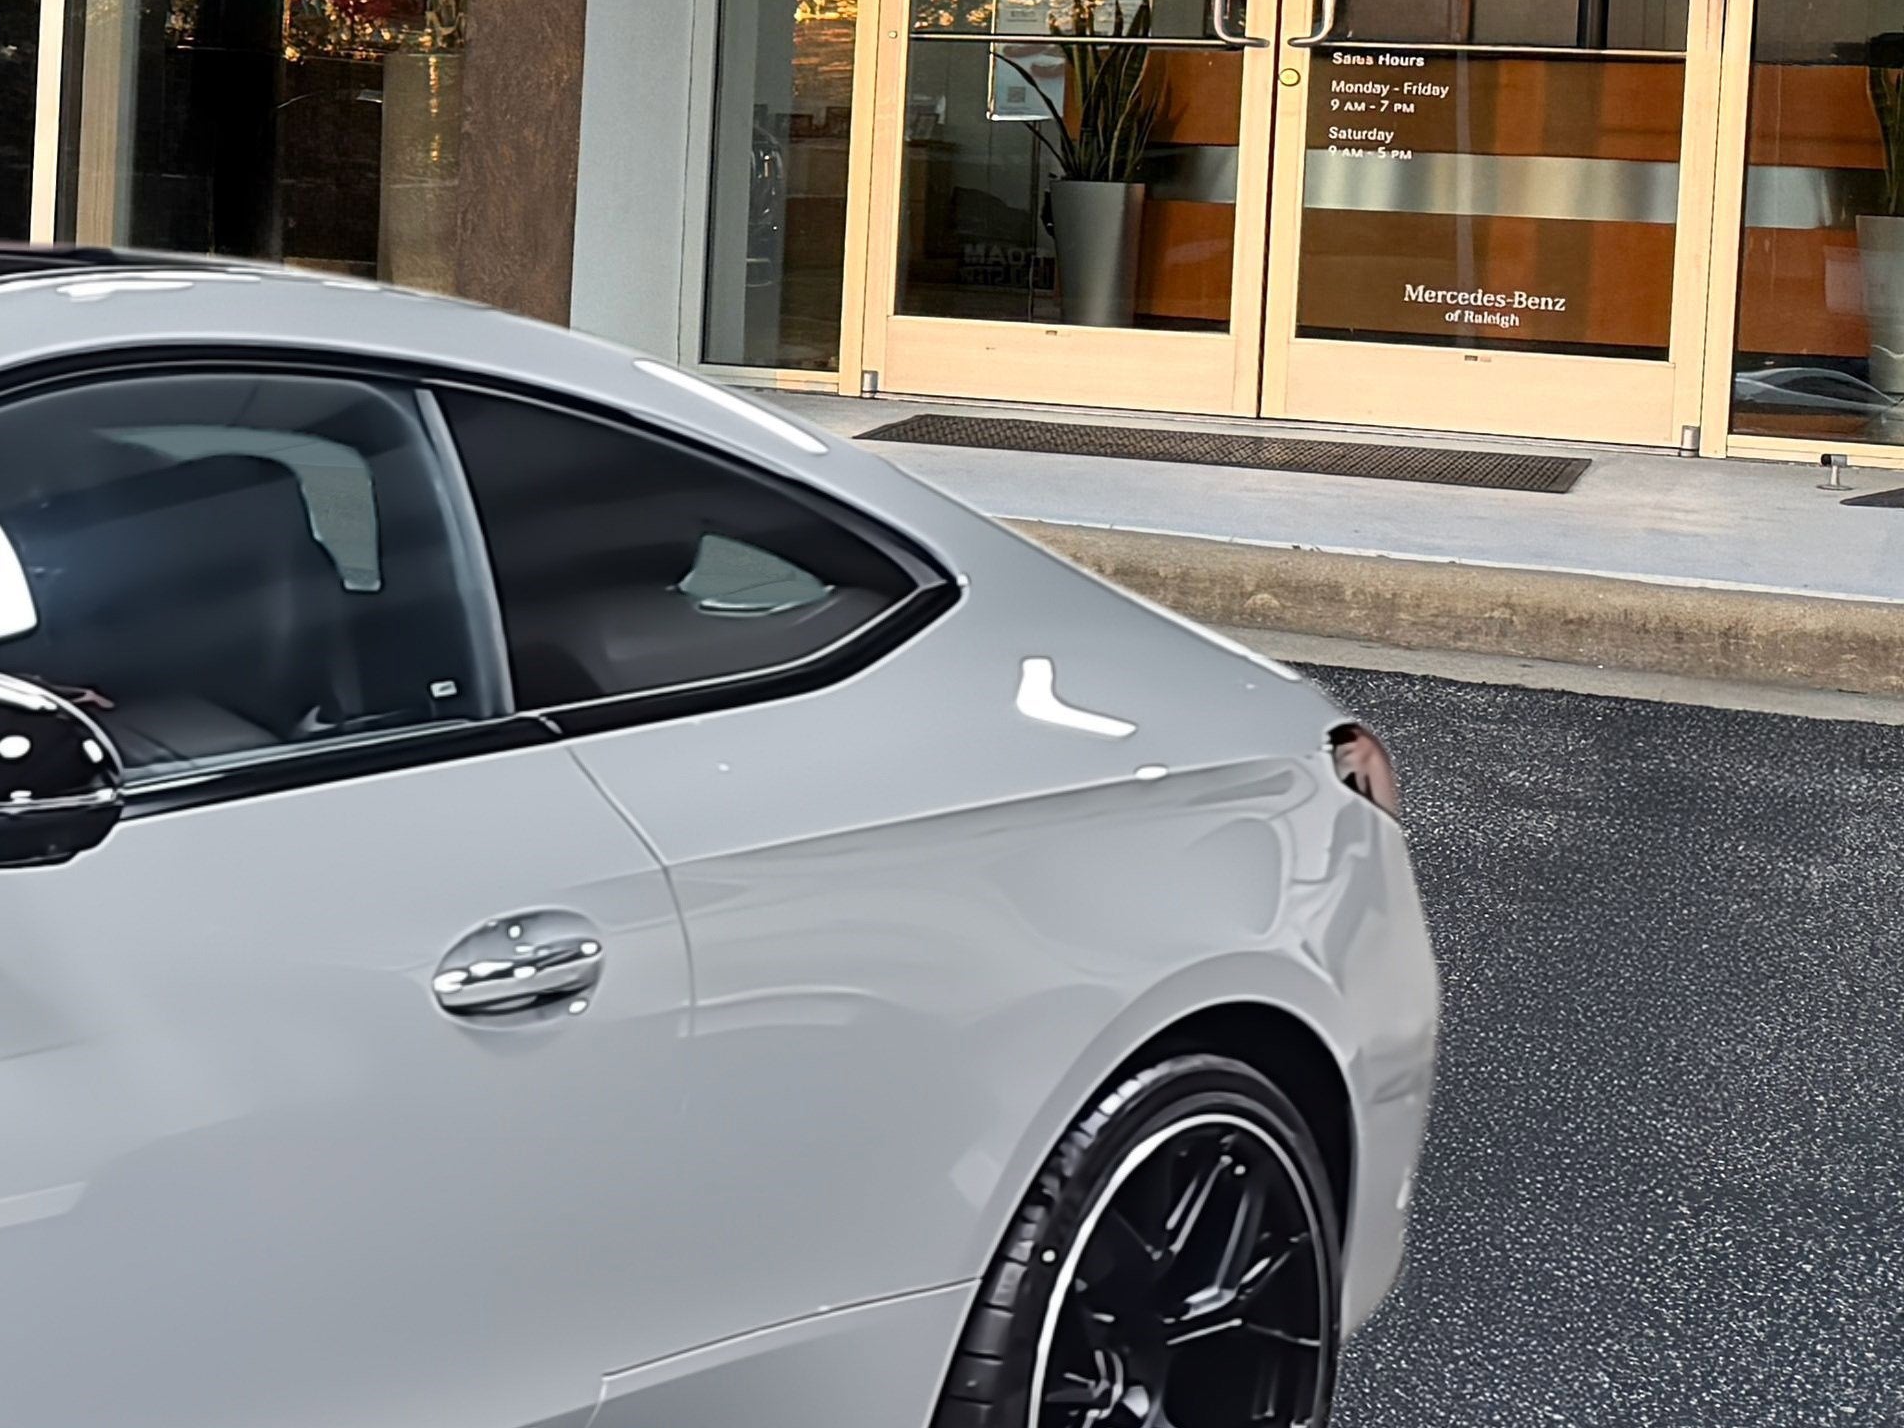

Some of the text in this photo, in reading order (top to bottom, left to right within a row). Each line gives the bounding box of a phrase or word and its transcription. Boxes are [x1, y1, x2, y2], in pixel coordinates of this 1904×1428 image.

[1378, 53, 1425, 67] Hours
[1331, 80, 1390, 97] Monday
[1403, 82, 1449, 98] Friday
[1330, 99, 1340, 111] 9
[1344, 101, 1366, 112] AM
[1379, 100, 1390, 112] 7
[1393, 103, 1415, 113] PM
[1328, 127, 1394, 143] Saturday
[1328, 145, 1337, 158] 9
[1342, 148, 1364, 158] AM
[1377, 147, 1387, 159] 5
[1391, 150, 1413, 160] PM
[1403, 283, 1566, 311] Mercedes-Benz
[1445, 310, 1520, 329] of Raleigh
